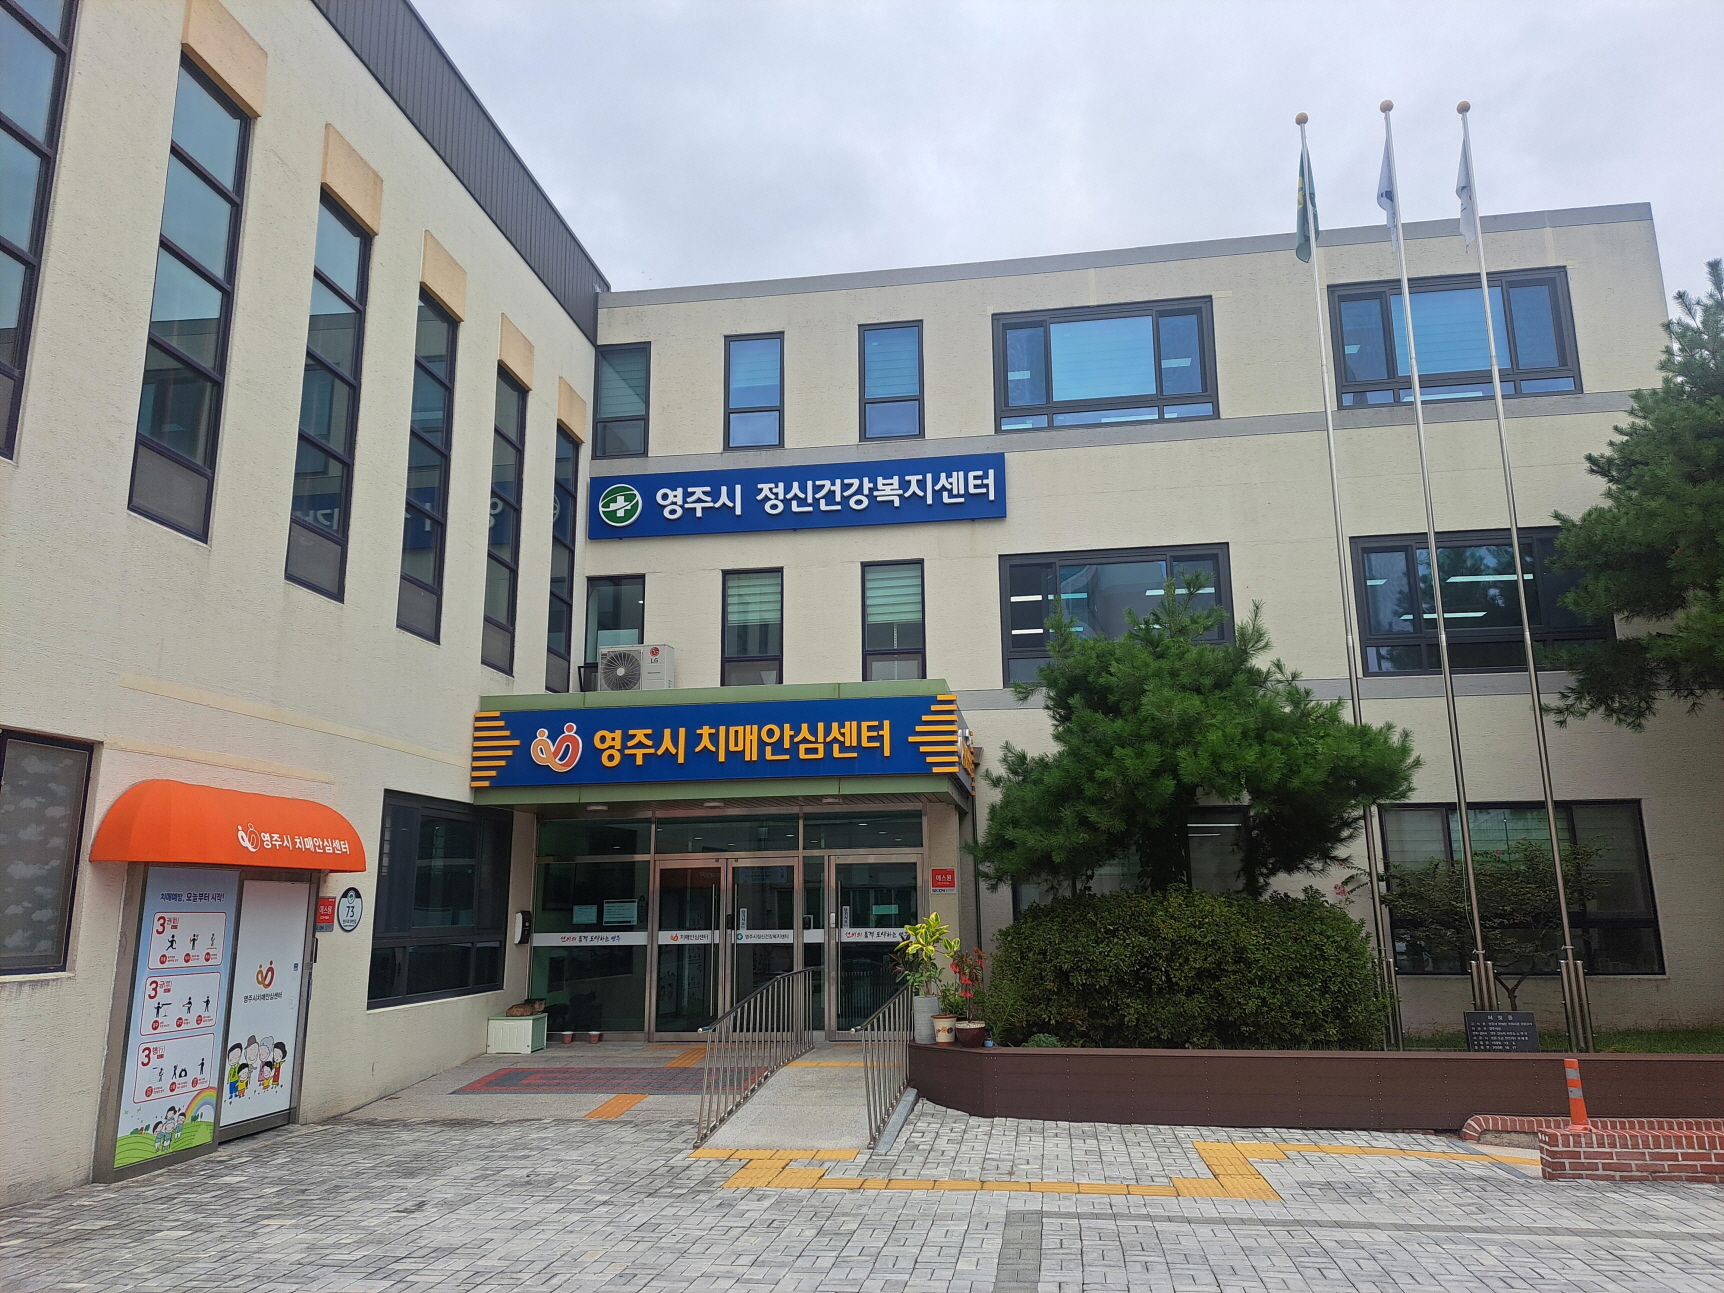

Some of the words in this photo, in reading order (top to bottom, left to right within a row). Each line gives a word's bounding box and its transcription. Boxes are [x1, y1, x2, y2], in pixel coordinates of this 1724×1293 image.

[655, 484, 742, 520] 영주시
[756, 468, 995, 515] 정신건강복지센터
[593, 727, 685, 767] 영주시
[695, 720, 891, 762] 치매안심센터
[261, 832, 292, 850] 영주시
[294, 835, 350, 855] 치매안심센터
[185, 892, 210, 902] 오늘부터
[211, 892, 225, 903] 시작!
[345, 906, 356, 918] 73
